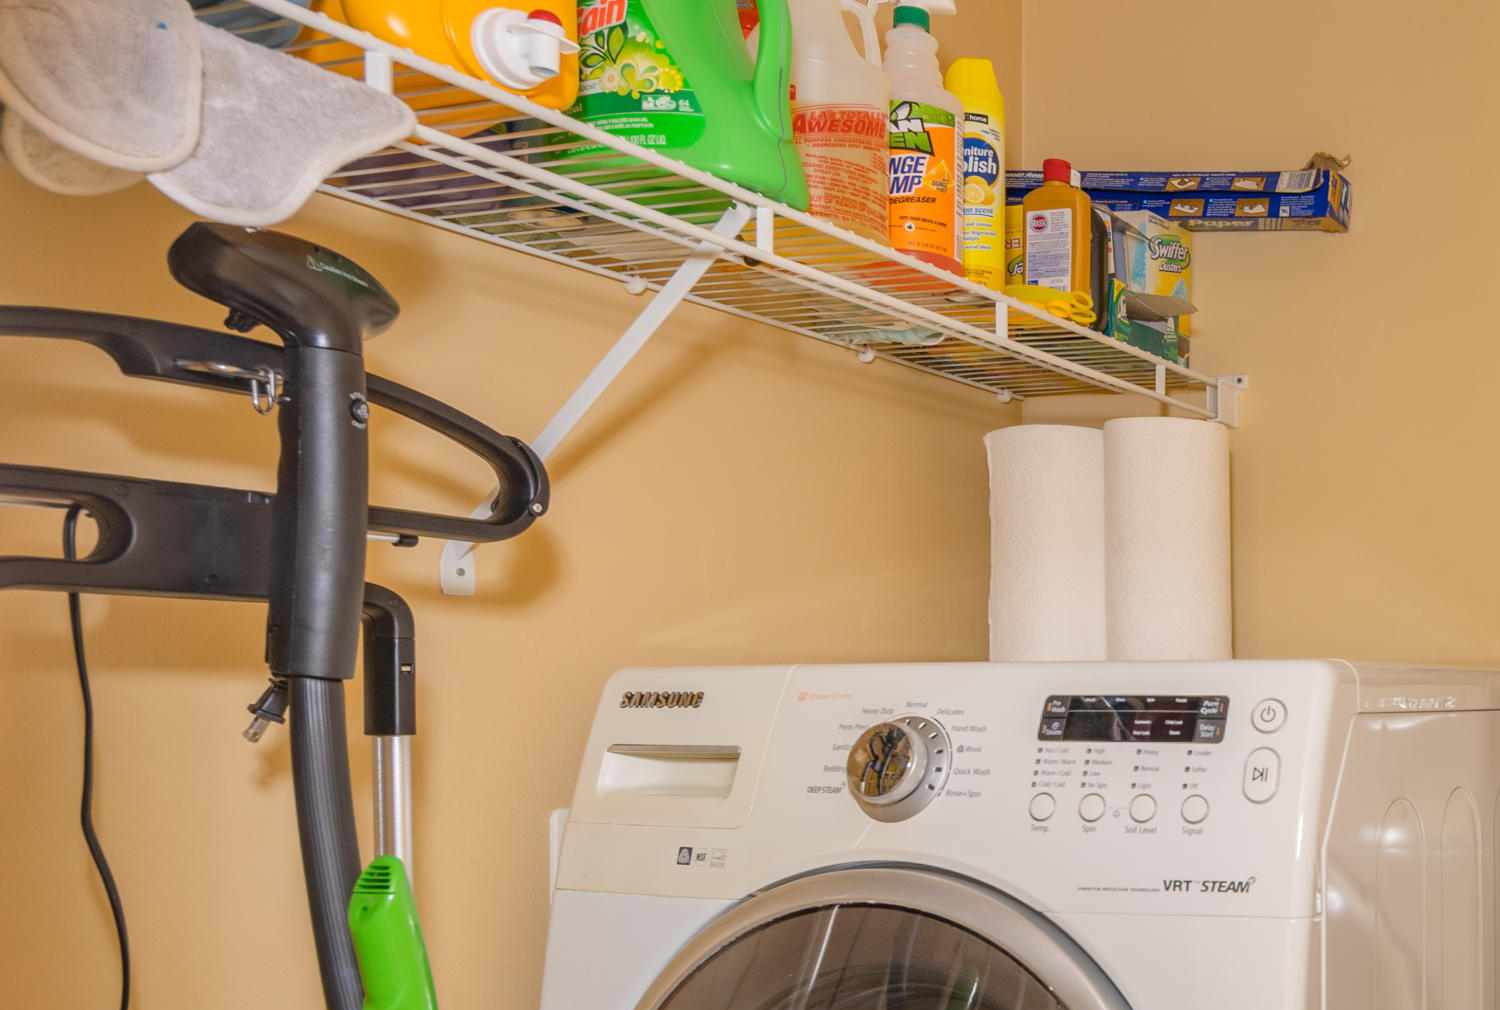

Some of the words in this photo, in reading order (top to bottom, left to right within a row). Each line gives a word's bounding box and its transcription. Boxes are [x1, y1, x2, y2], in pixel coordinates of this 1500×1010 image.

[793, 112, 886, 138] AWESOME
[889, 196, 936, 204] DEGREASER
[1151, 238, 1189, 260] Swiffer
[1160, 262, 1182, 273] Dusters
[620, 691, 704, 708] SAMSUNG
[1081, 825, 1097, 834] Spin
[1124, 826, 1137, 834] Soil
[1138, 826, 1157, 835] Level
[1182, 827, 1203, 836] Signal
[1163, 880, 1192, 892] VRT
[1200, 880, 1250, 893] STEAM
